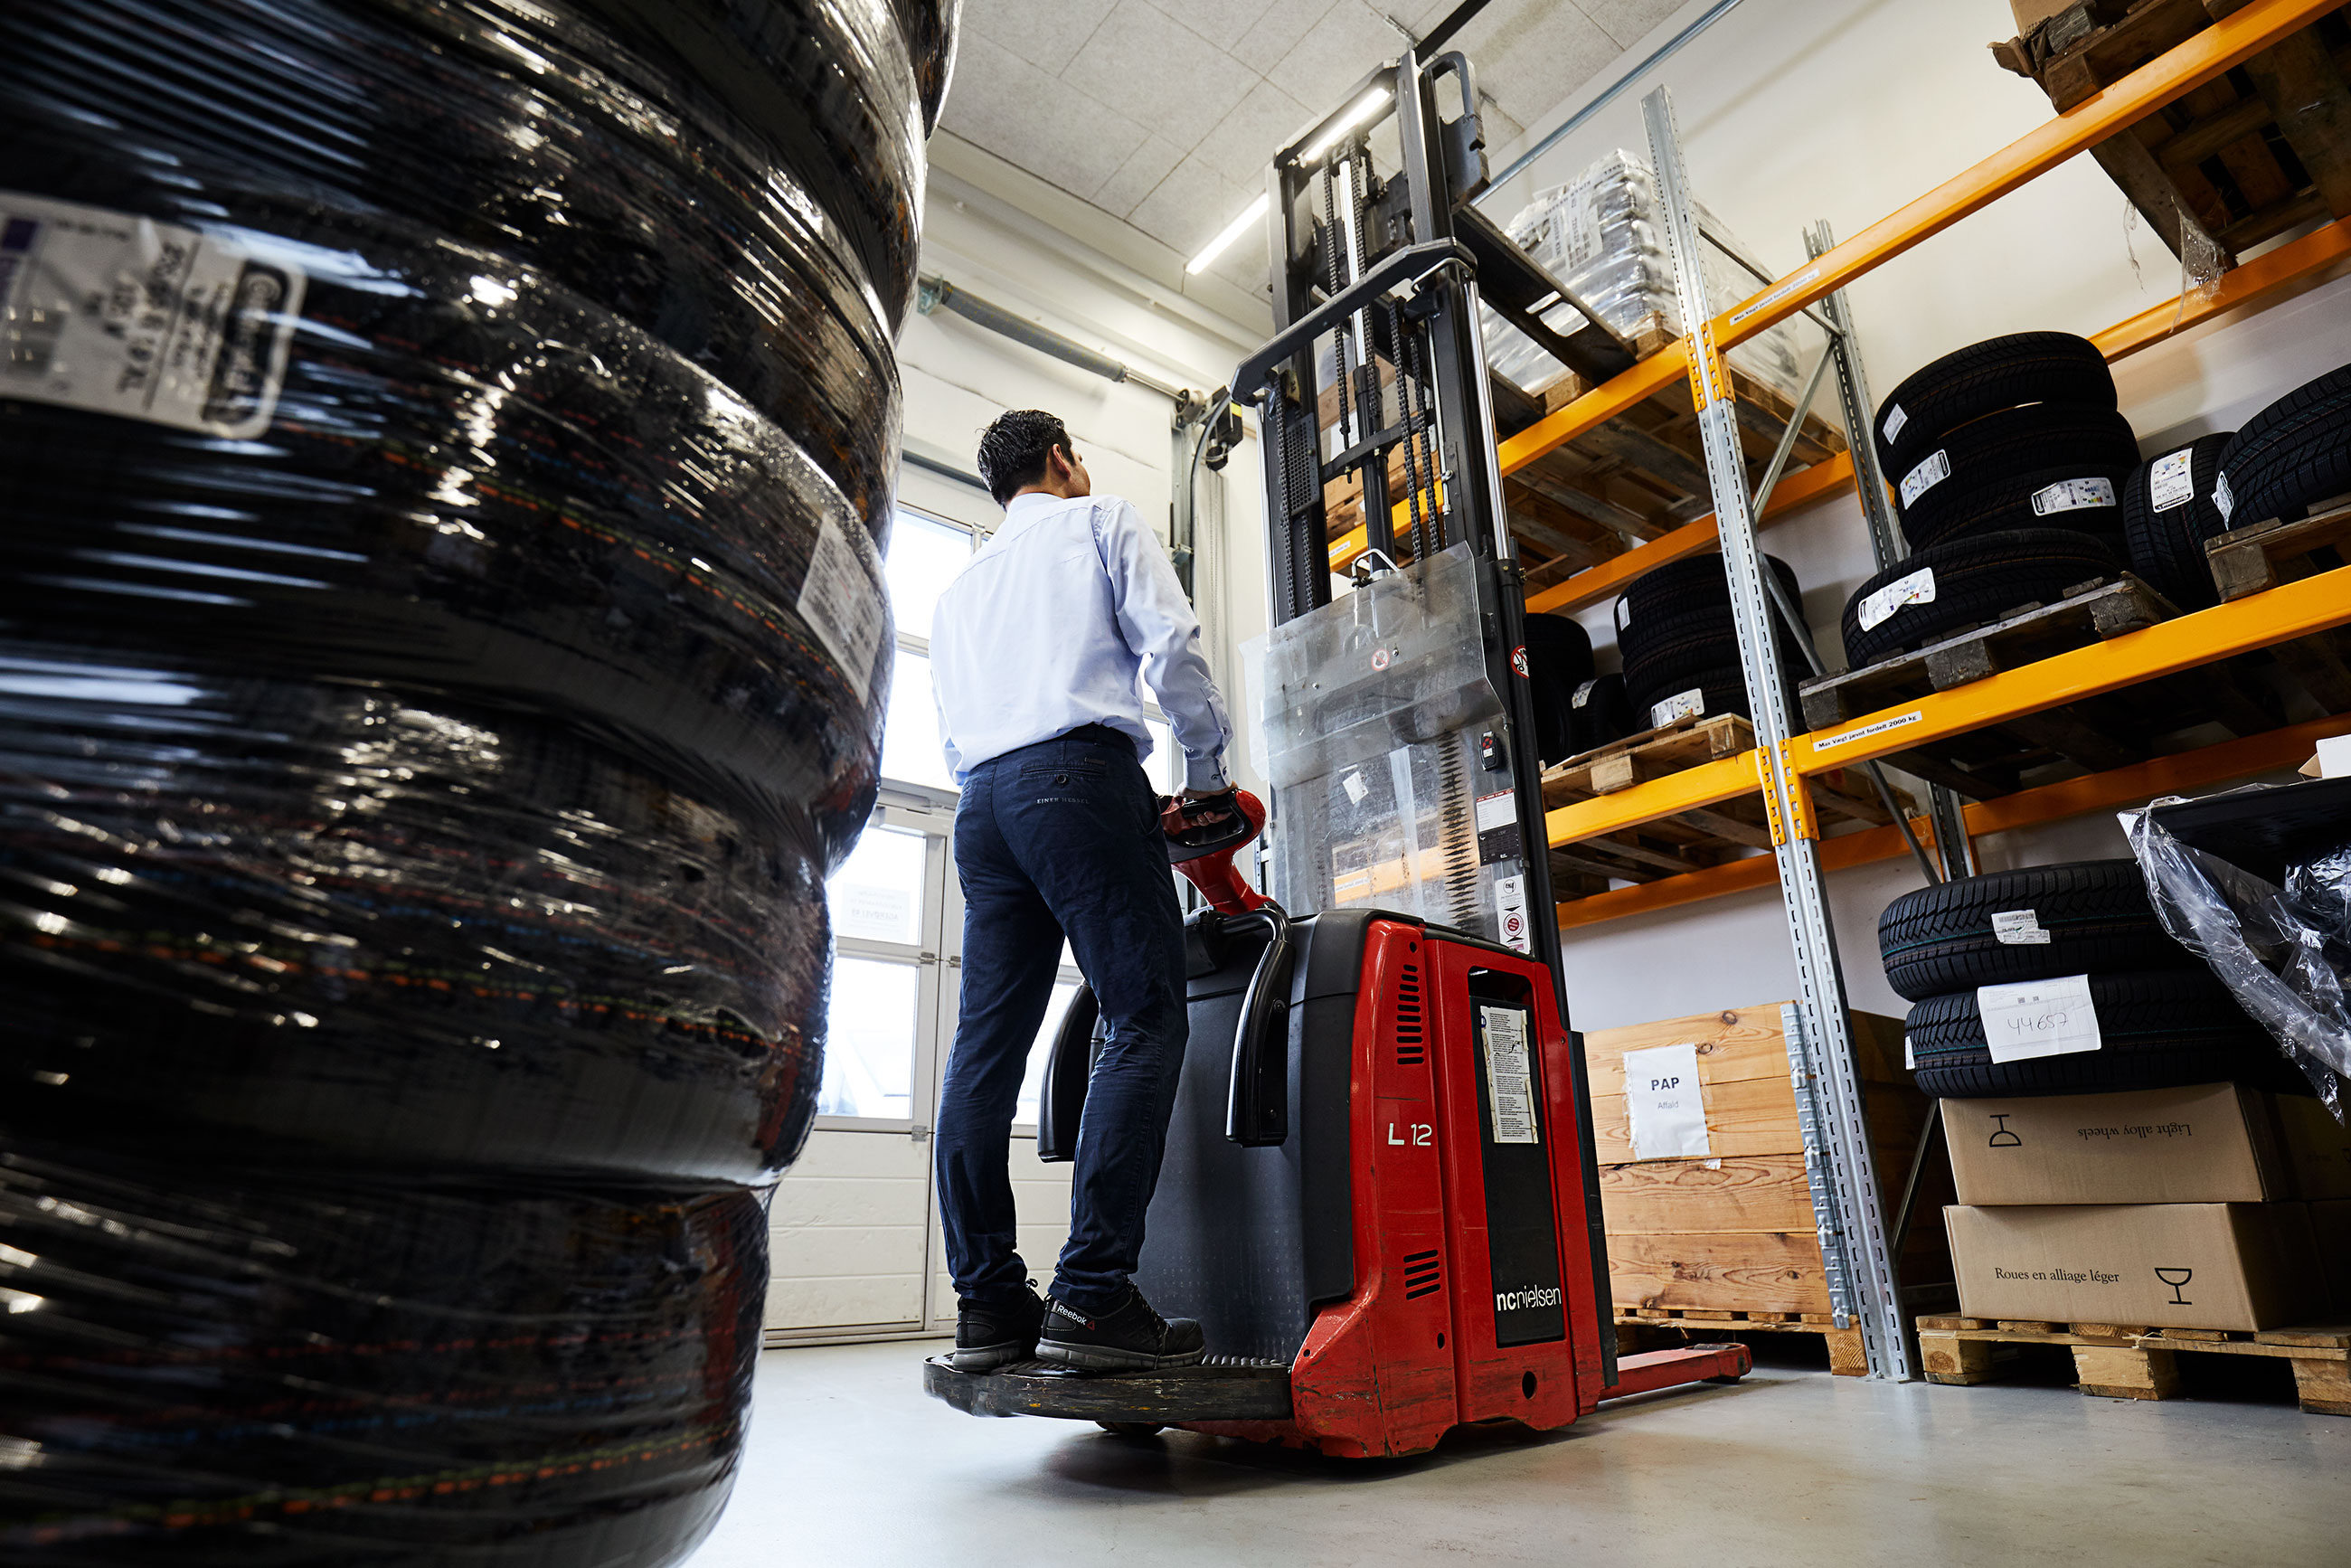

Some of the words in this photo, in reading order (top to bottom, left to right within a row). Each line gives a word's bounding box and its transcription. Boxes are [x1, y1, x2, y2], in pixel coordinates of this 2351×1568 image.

[1832, 735, 1847, 745] Vægt
[1848, 731, 1865, 741] jævnt
[1866, 723, 1887, 733] fordelt
[1888, 717, 1907, 728] 2000
[2006, 1012, 2069, 1035] 44657
[1651, 1076, 1680, 1091] PAP
[1657, 1100, 1679, 1110] Affald
[1388, 1123, 1404, 1146] L
[1410, 1124, 1432, 1147] 12
[2078, 1128, 2119, 1140] wheels
[2122, 1124, 2154, 1138] alloy
[2157, 1122, 2193, 1138] Light
[1995, 1267, 2030, 1280] Roues
[2033, 1271, 2047, 1281] en
[2049, 1268, 2087, 1284] alliage
[2090, 1267, 2120, 1284] léger
[1496, 1284, 1563, 1313] ncnielsen
[1057, 1305, 1087, 1326] Reebok
